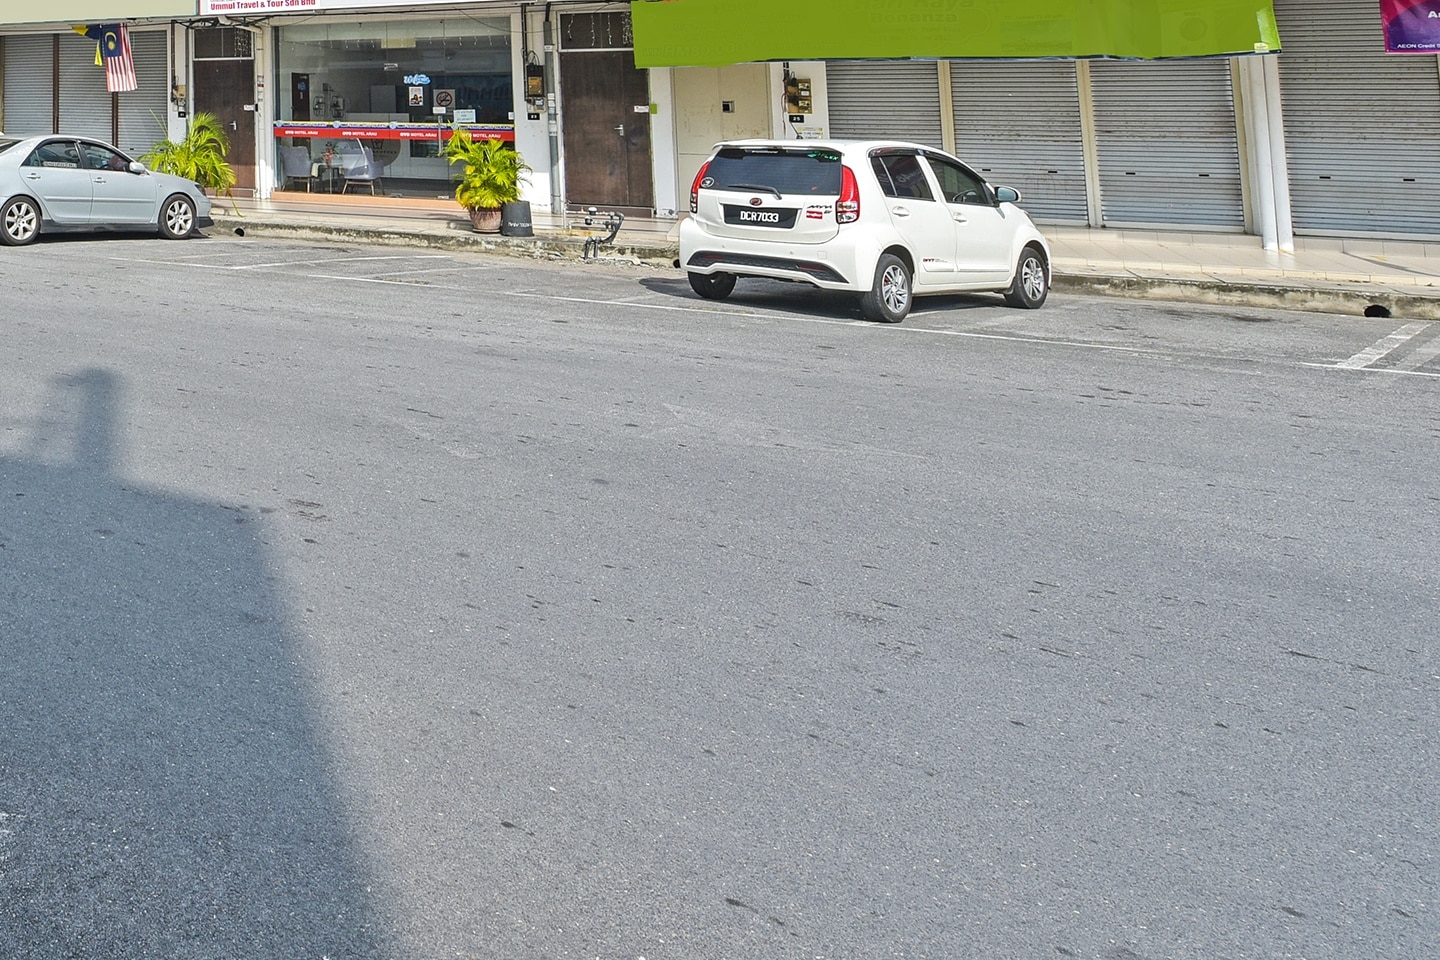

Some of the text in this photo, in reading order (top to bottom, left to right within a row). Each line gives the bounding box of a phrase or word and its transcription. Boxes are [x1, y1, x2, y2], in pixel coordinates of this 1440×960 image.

[210, 1, 236, 11] Ummul
[236, 0, 259, 9] Travel
[260, 0, 266, 8] &
[267, 0, 283, 8] Tour
[740, 210, 779, 222] DCR7033
